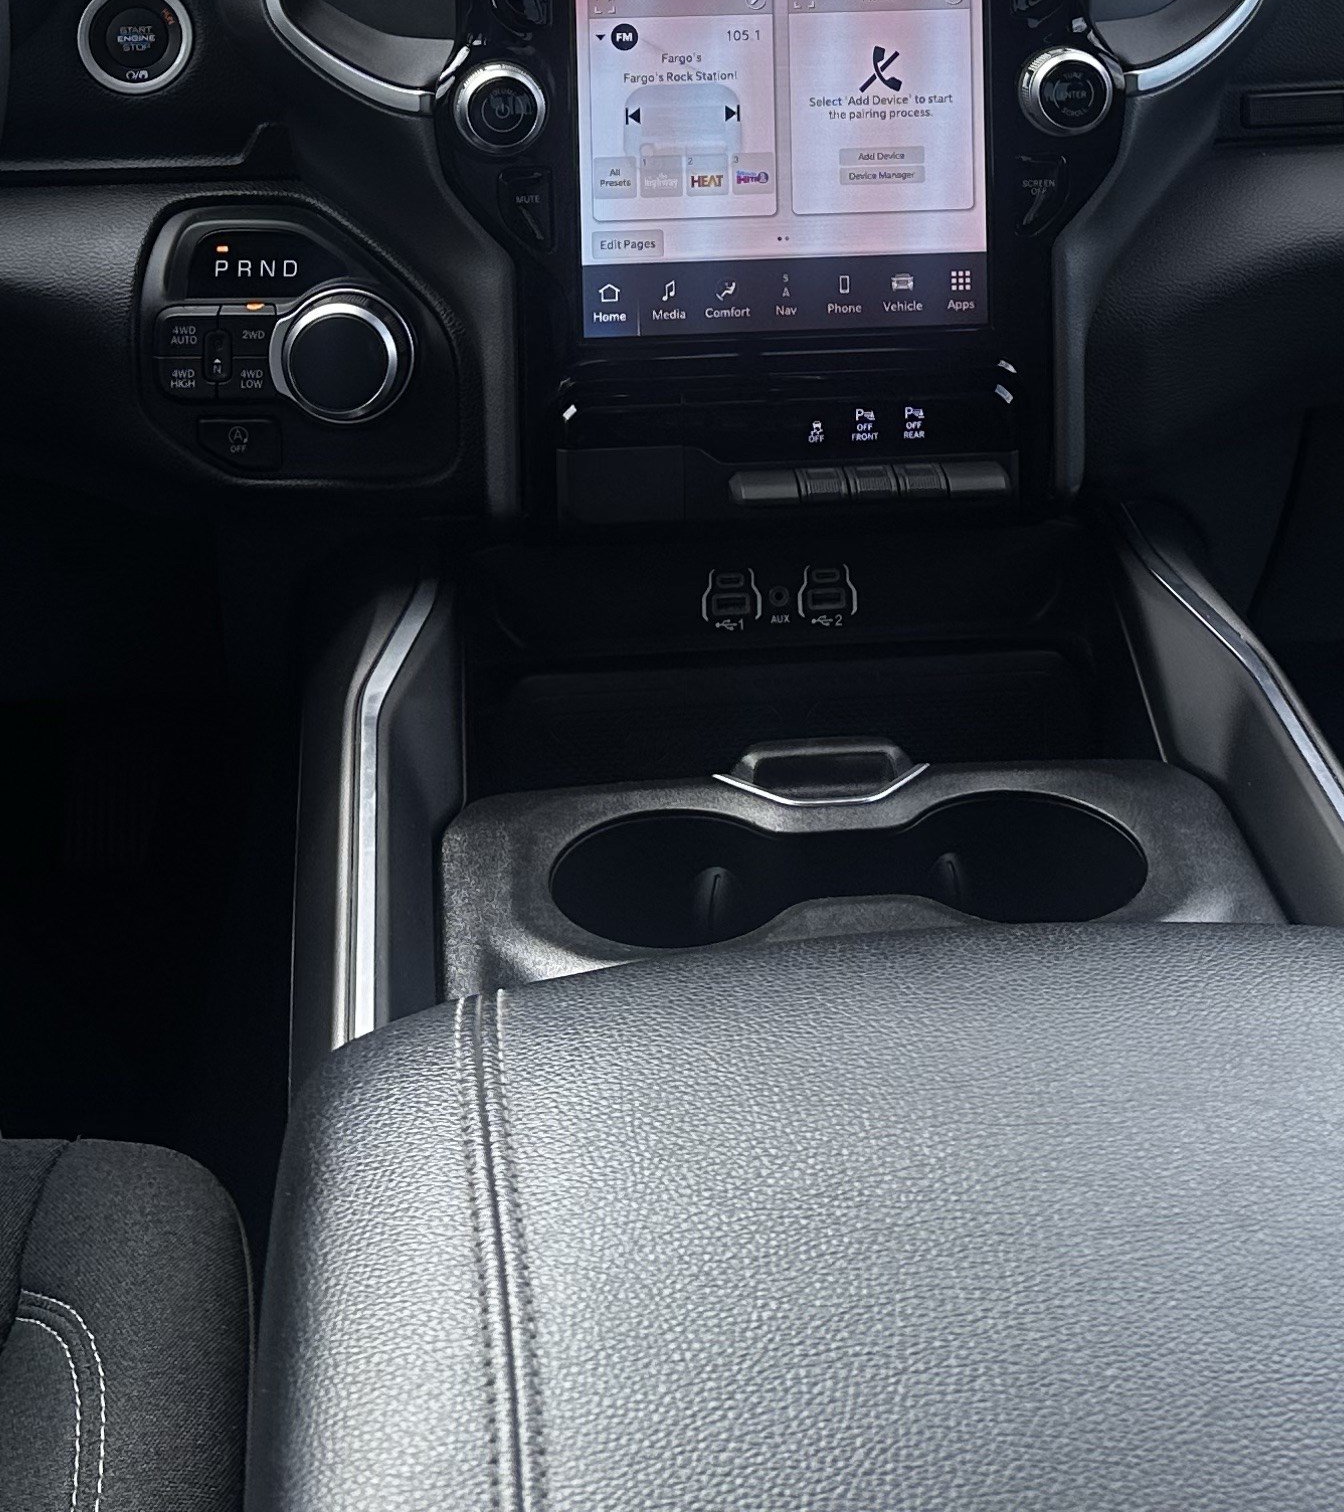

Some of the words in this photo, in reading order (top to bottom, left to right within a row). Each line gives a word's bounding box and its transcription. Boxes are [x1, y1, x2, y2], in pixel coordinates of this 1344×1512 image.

[117, 34, 155, 42] ENGINE
[616, 32, 633, 42] FM
[661, 52, 702, 65] Fargo's
[624, 72, 665, 84] Fargo's
[666, 72, 693, 82] Rock
[695, 70, 738, 82] Station!
[809, 96, 842, 107] Select
[914, 95, 926, 104] to
[927, 94, 953, 103] start
[829, 110, 846, 120] the
[849, 109, 886, 121] pairing
[858, 152, 875, 160] Add
[877, 152, 905, 160] Device
[849, 172, 877, 180] Device
[878, 171, 915, 181] Manager
[600, 179, 631, 187] Presets
[691, 175, 723, 187] HEAT
[515, 195, 540, 204] MUTE
[601, 239, 622, 250] Edit
[624, 239, 656, 252] Pages
[593, 311, 626, 323] Home
[652, 309, 686, 321] Media
[705, 306, 751, 318] Comfort
[775, 305, 797, 316] Nav
[827, 302, 862, 314] Phone
[882, 300, 923, 312] Vehicle
[946, 299, 975, 311] Apps
[173, 326, 196, 334] 4WD
[242, 331, 265, 339] 2WD
[171, 336, 197, 345] AUTO
[172, 369, 195, 378] 4WD
[241, 369, 263, 378] 4WD
[171, 380, 196, 388] HIGH
[241, 380, 263, 389] LOW
[856, 423, 873, 431] OFF
[905, 420, 922, 430] OFF
[808, 435, 824, 443] OFF
[851, 432, 878, 441] FRONT
[903, 430, 925, 439] REAR
[230, 445, 247, 453] OFF
[770, 614, 790, 623] AUX
